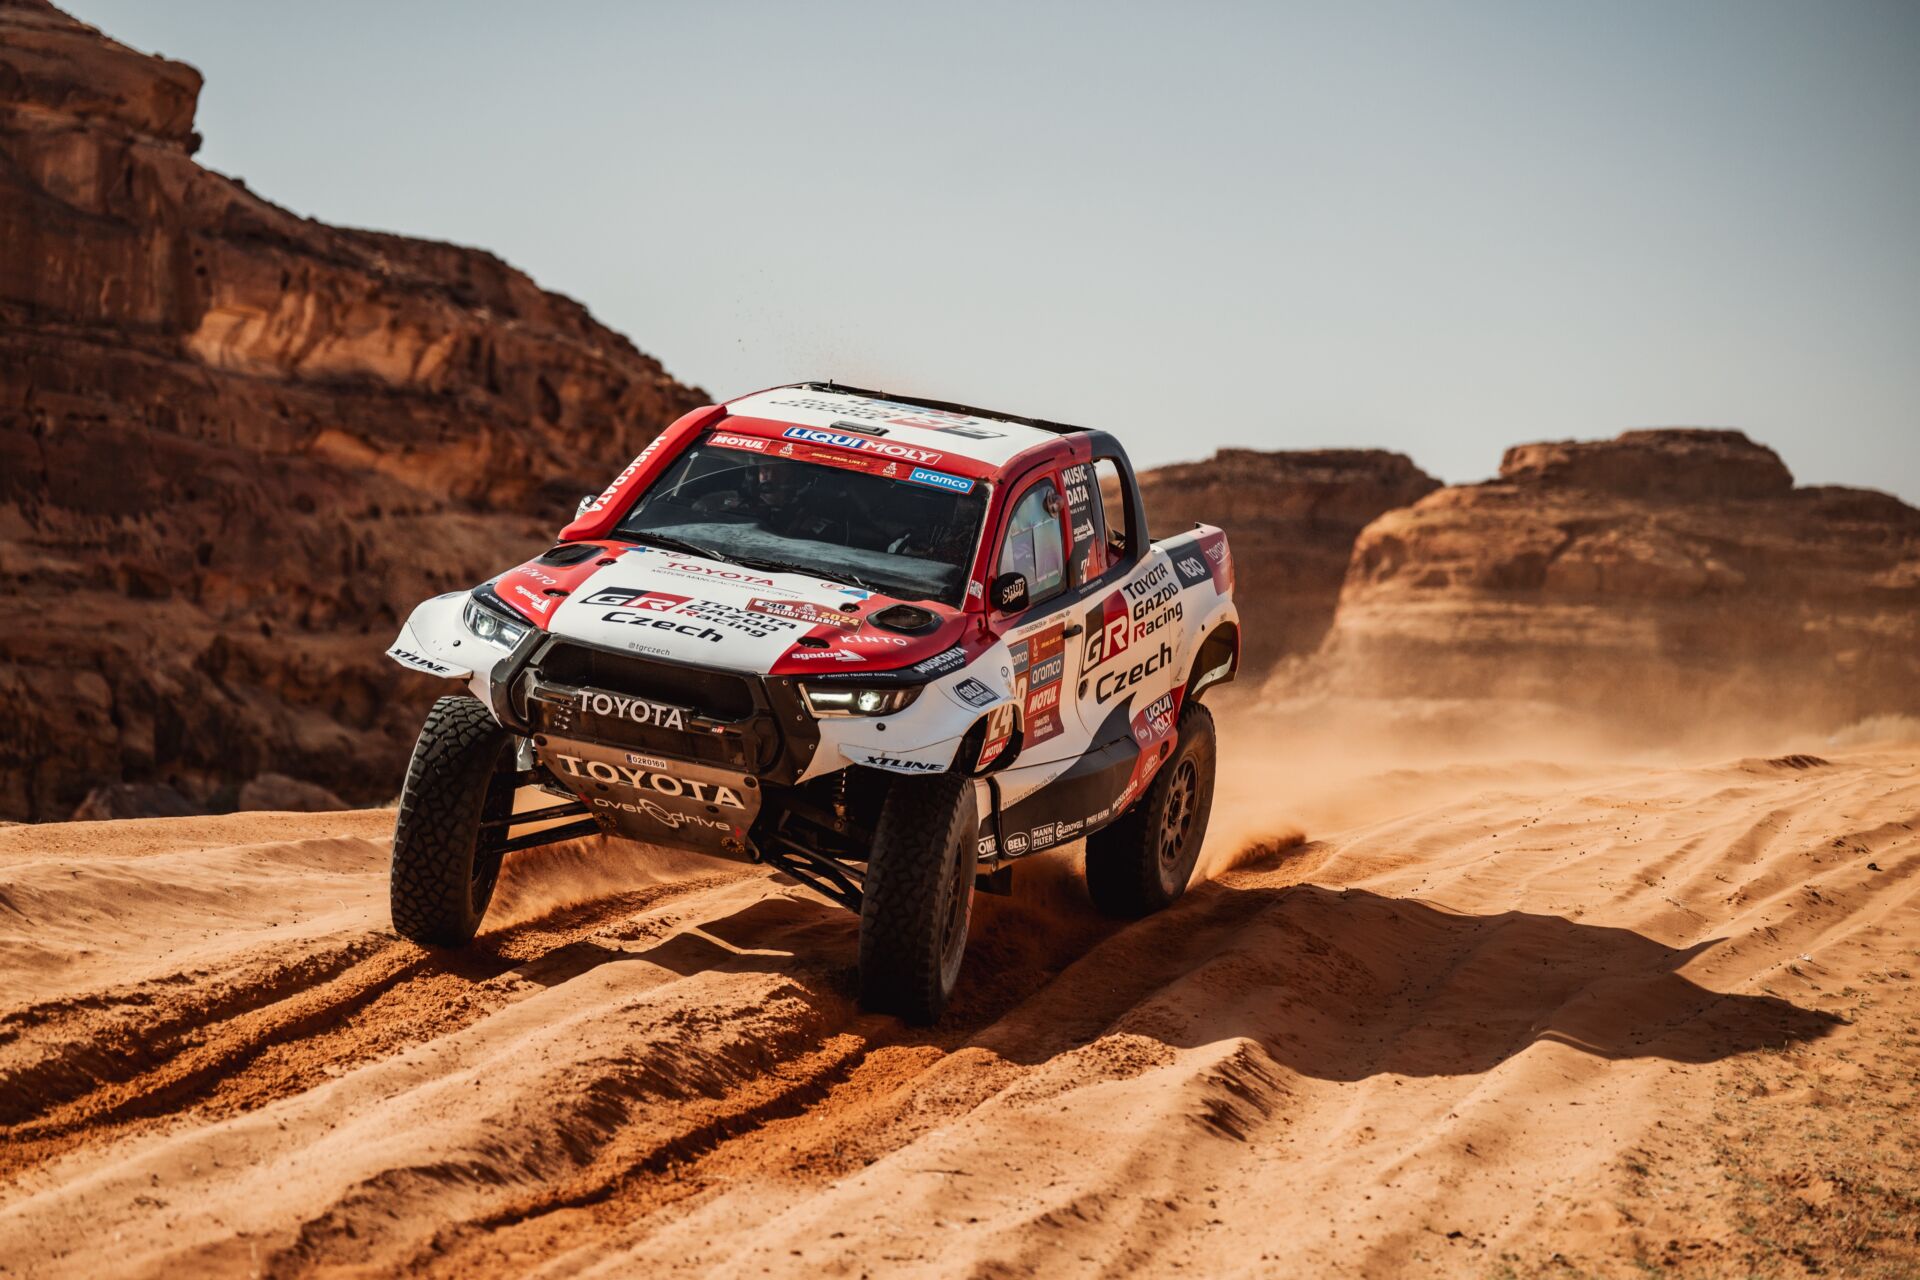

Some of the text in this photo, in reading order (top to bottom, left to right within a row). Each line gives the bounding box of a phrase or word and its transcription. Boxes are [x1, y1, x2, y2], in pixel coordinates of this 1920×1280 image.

[712, 435, 765, 449] MOTUL
[787, 428, 938, 464] LIQUI MOLY
[587, 435, 667, 512] MUSICDATA
[915, 470, 968, 489] aramco
[1062, 464, 1087, 488] MUSIC
[1066, 485, 1089, 506] DATA
[1205, 541, 1225, 560] TOYOTA
[667, 561, 774, 586] TOYOTA
[1123, 563, 1169, 600] TOYOTA
[582, 591, 681, 612] GR
[1002, 581, 1025, 605] SHOT
[1133, 582, 1179, 622] GAZOO
[686, 603, 779, 632] GAZOO
[700, 599, 797, 630] TOYOTA
[762, 601, 786, 610] 248
[766, 608, 841, 626] SAUDI ARABIA
[601, 611, 724, 643] Czech
[675, 608, 768, 638] Racing
[820, 612, 860, 626] 2024
[1133, 601, 1184, 643] Racing
[628, 641, 671, 656] @tgrczech
[840, 634, 908, 647] KINTO
[1081, 606, 1128, 673] GR
[390, 648, 451, 674] XTLINE
[791, 650, 843, 661] agados
[913, 646, 968, 674] MUSICDATA
[1012, 651, 1028, 666] amco
[1032, 660, 1061, 684] aramco
[1096, 642, 1173, 704] Czech
[958, 682, 985, 699] GOLD
[1029, 685, 1057, 714] MOTUL
[578, 690, 684, 731] TOYOTA
[1146, 695, 1171, 722] LIQUI
[1152, 710, 1173, 732] MOLY
[983, 742, 1003, 759] MOTUL
[864, 756, 945, 771] XTLINE
[557, 754, 746, 810] TOYOTA
[1007, 836, 1028, 850] BELL
[1033, 826, 1053, 837] MANN
[1034, 835, 1053, 847] FILTER
